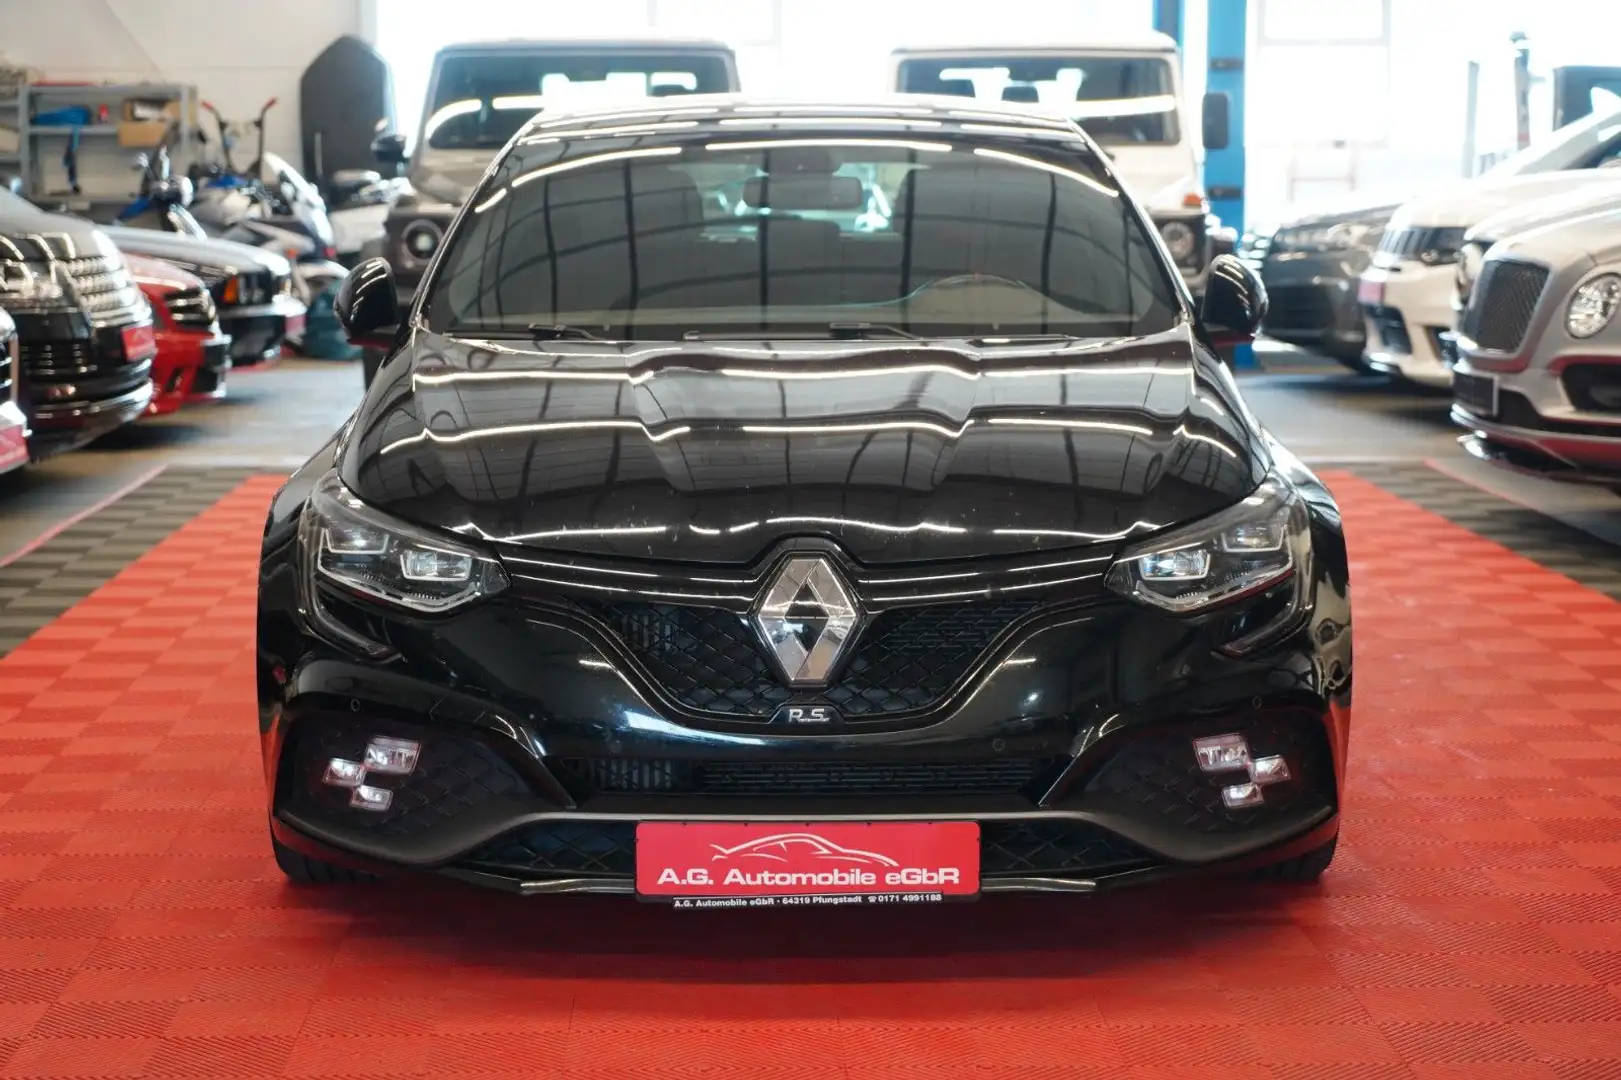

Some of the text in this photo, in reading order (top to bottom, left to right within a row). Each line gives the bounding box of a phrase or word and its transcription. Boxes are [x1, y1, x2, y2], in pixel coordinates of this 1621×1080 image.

[657, 867, 960, 886] A.G. Automobile eGbR
[674, 900, 693, 908] A.G.
[696, 899, 747, 907] Automobile
[750, 897, 774, 906] eGbR
[782, 896, 810, 905] 64319
[878, 894, 900, 902] 0171
